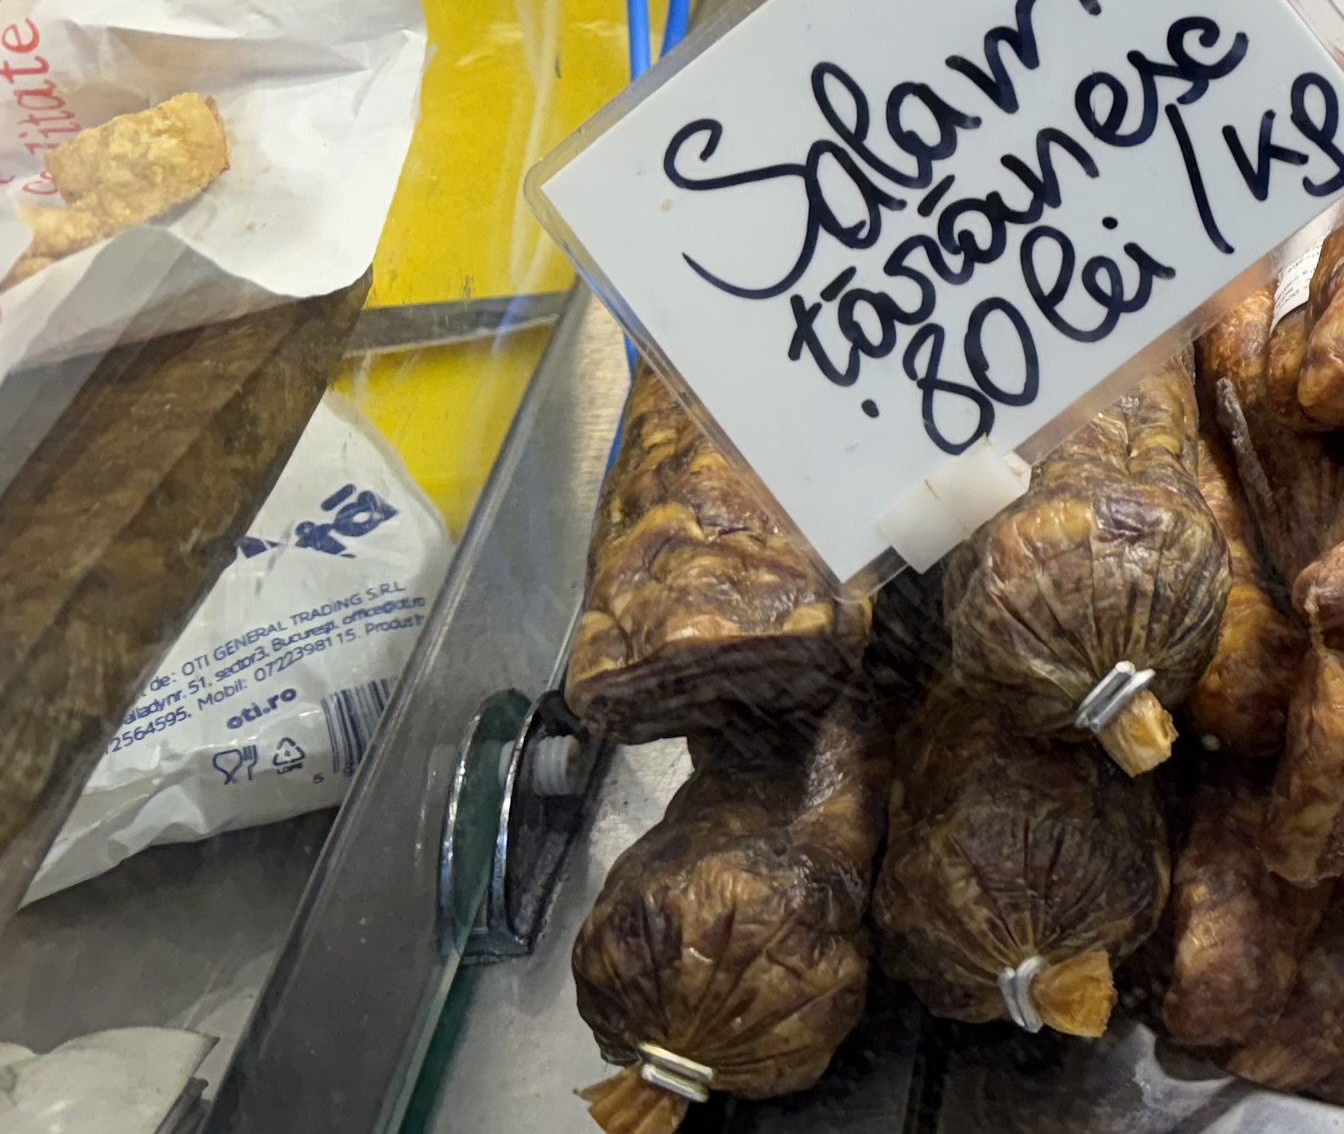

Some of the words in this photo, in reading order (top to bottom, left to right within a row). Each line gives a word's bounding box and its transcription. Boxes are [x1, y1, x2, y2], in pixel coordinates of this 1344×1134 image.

[903, 296, 1040, 457] 80
[1018, 216, 1177, 344] lei
[149, 675, 177, 692] de:
[181, 654, 210, 677] OTI
[213, 621, 288, 662] GENERAL
[290, 593, 363, 626] TRADING
[197, 678, 248, 711] Mobil:
[226, 688, 297, 730] oti.ro
[313, 772, 325, 785] 5
